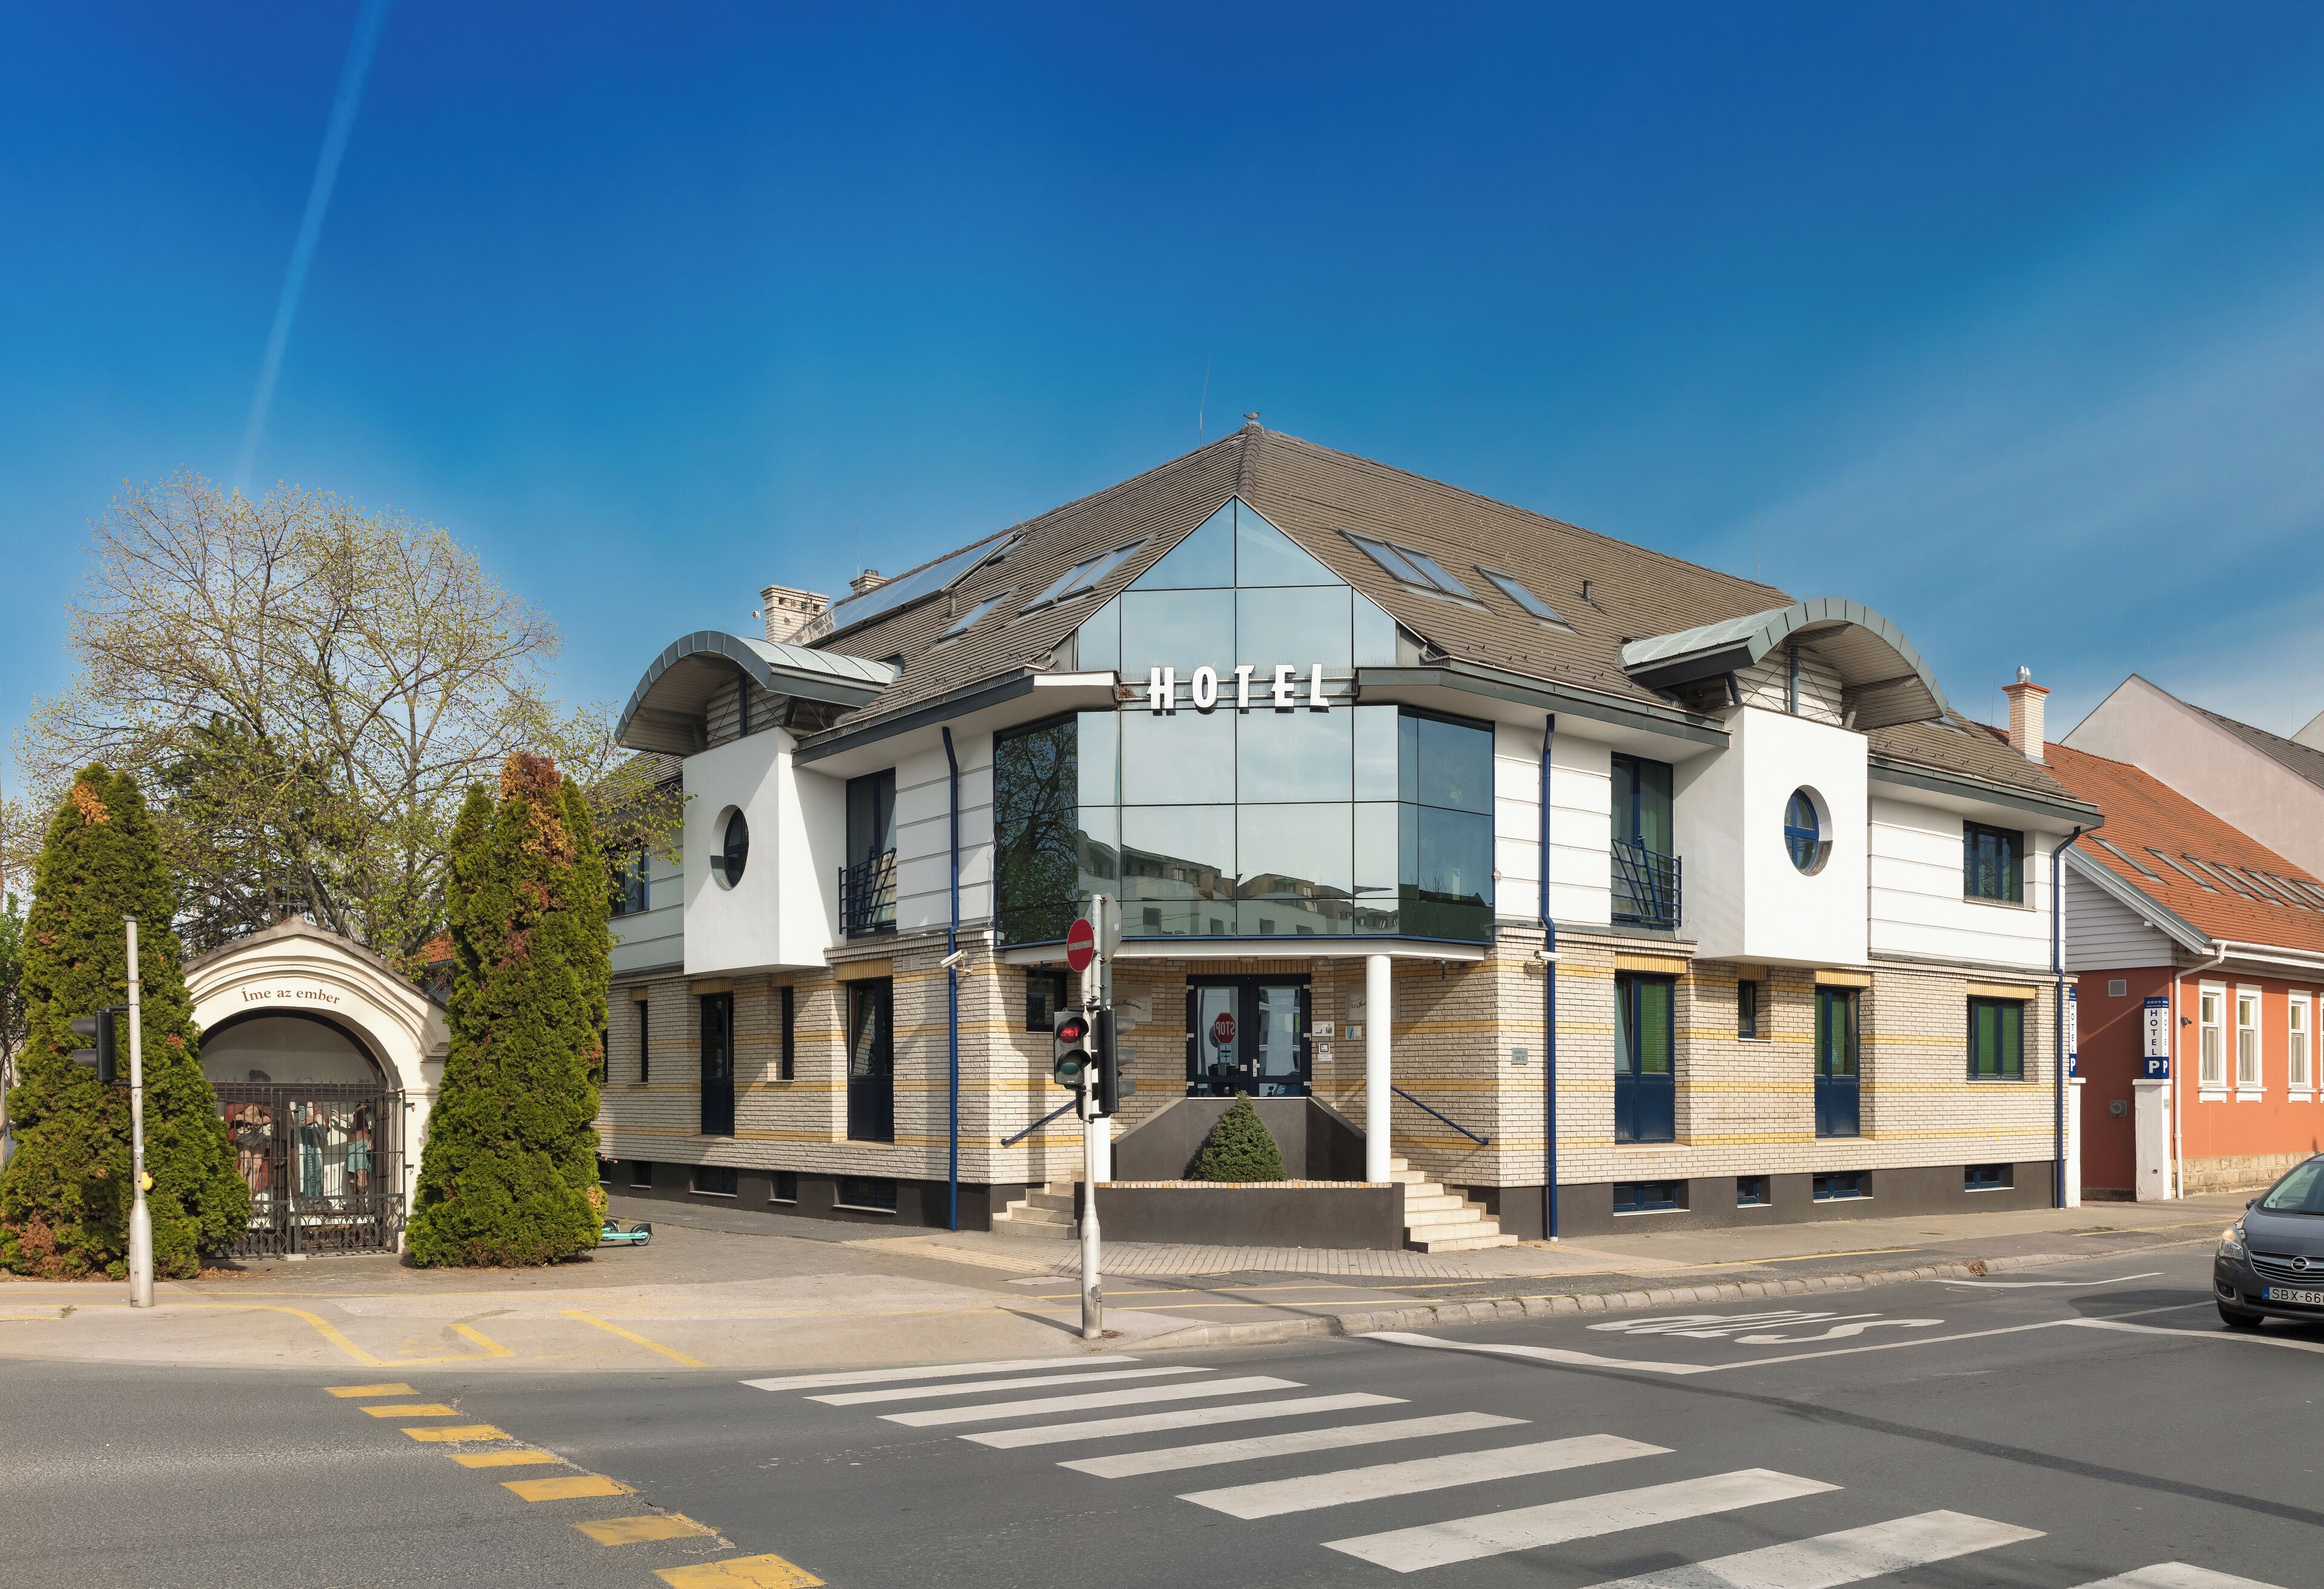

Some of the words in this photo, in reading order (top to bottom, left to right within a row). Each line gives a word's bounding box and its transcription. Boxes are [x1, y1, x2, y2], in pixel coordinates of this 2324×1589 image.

[1146, 663, 1330, 710] HOTEL
[241, 987, 272, 1002] Íme
[277, 989, 292, 998] az
[296, 989, 340, 1004] ember
[2150, 1009, 2158, 1055] HOTEL
[2070, 1058, 2076, 1072] P
[2148, 1060, 2160, 1073] P
[2163, 1060, 2168, 1073] P
[2271, 1288, 2324, 1303] SBX-66
